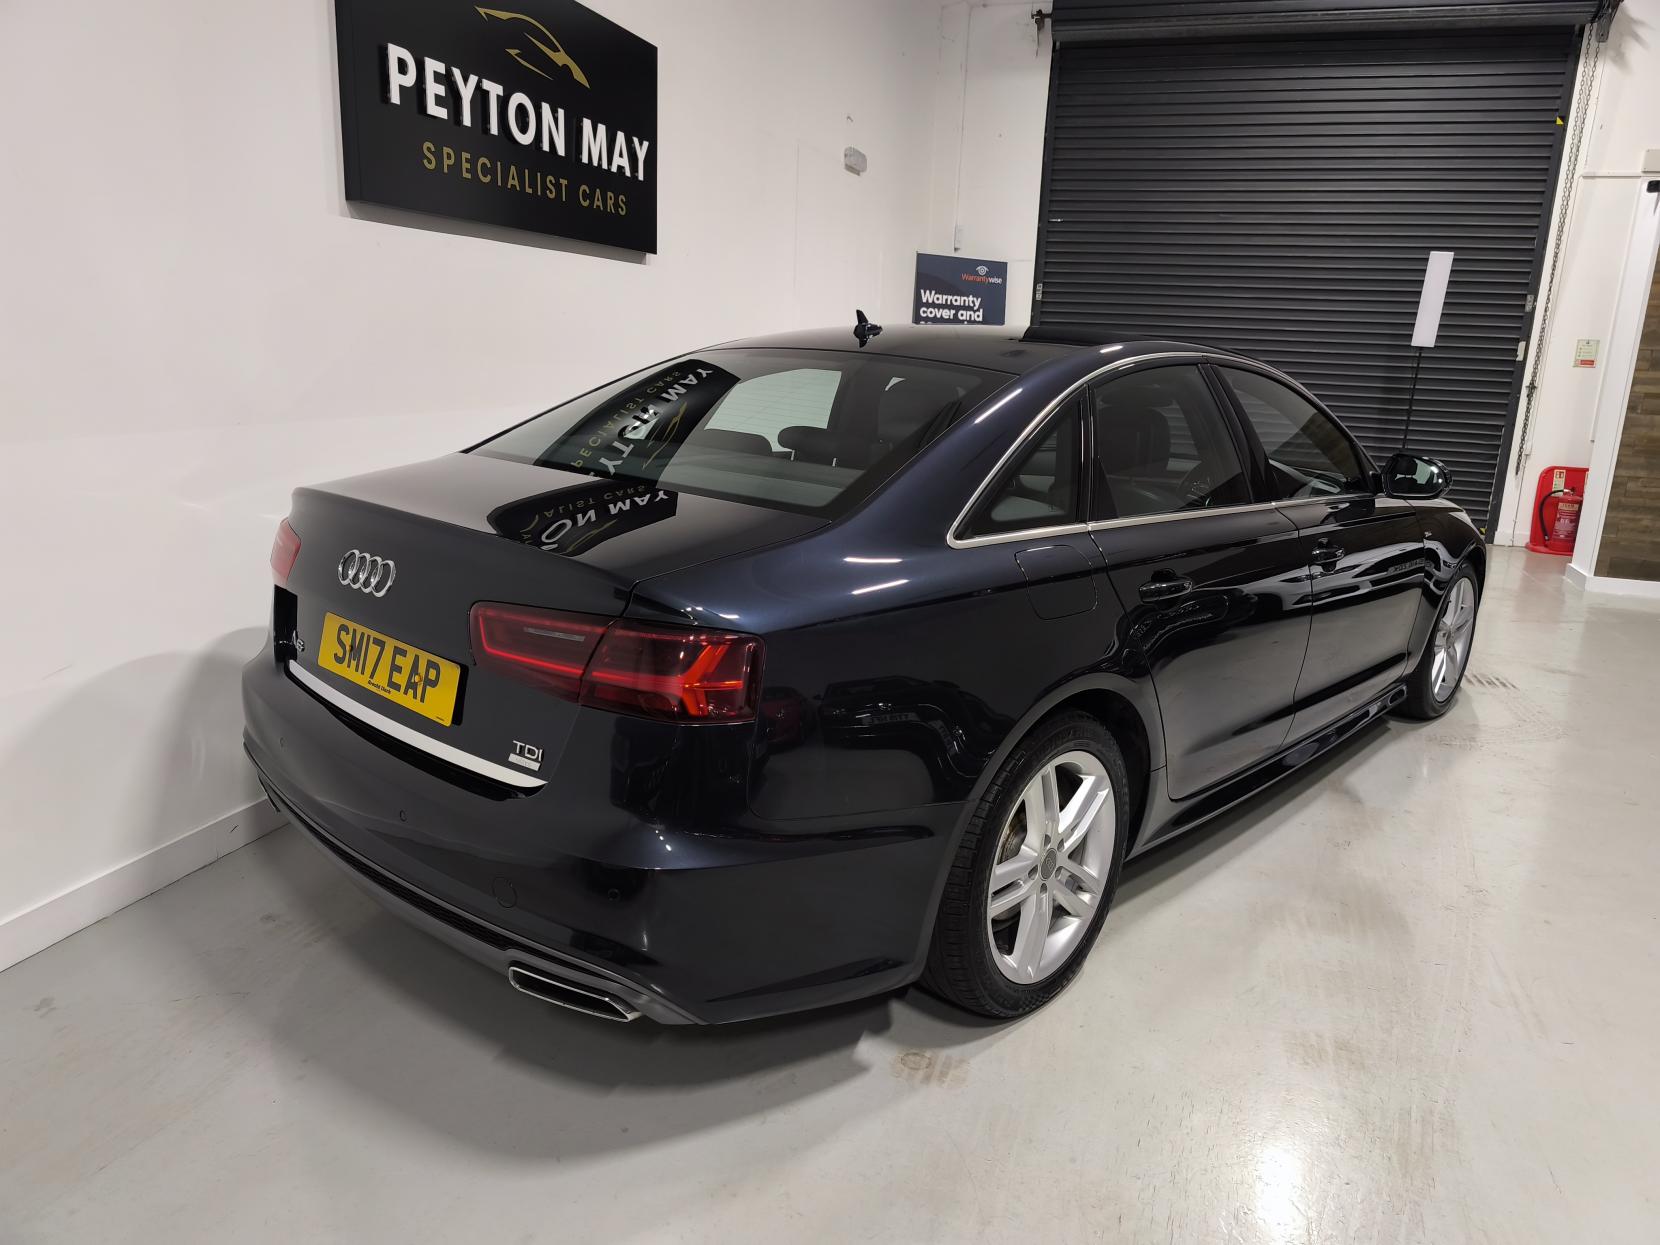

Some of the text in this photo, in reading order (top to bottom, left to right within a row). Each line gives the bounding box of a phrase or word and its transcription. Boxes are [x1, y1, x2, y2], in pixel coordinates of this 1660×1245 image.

[387, 43, 649, 181] PEYTON MAY
[422, 141, 627, 216] SPECIALIST CARS
[919, 306, 984, 322] cover and
[920, 288, 982, 310] Warranty
[333, 623, 441, 704] SM17 EAP
[512, 740, 543, 762] TDI
